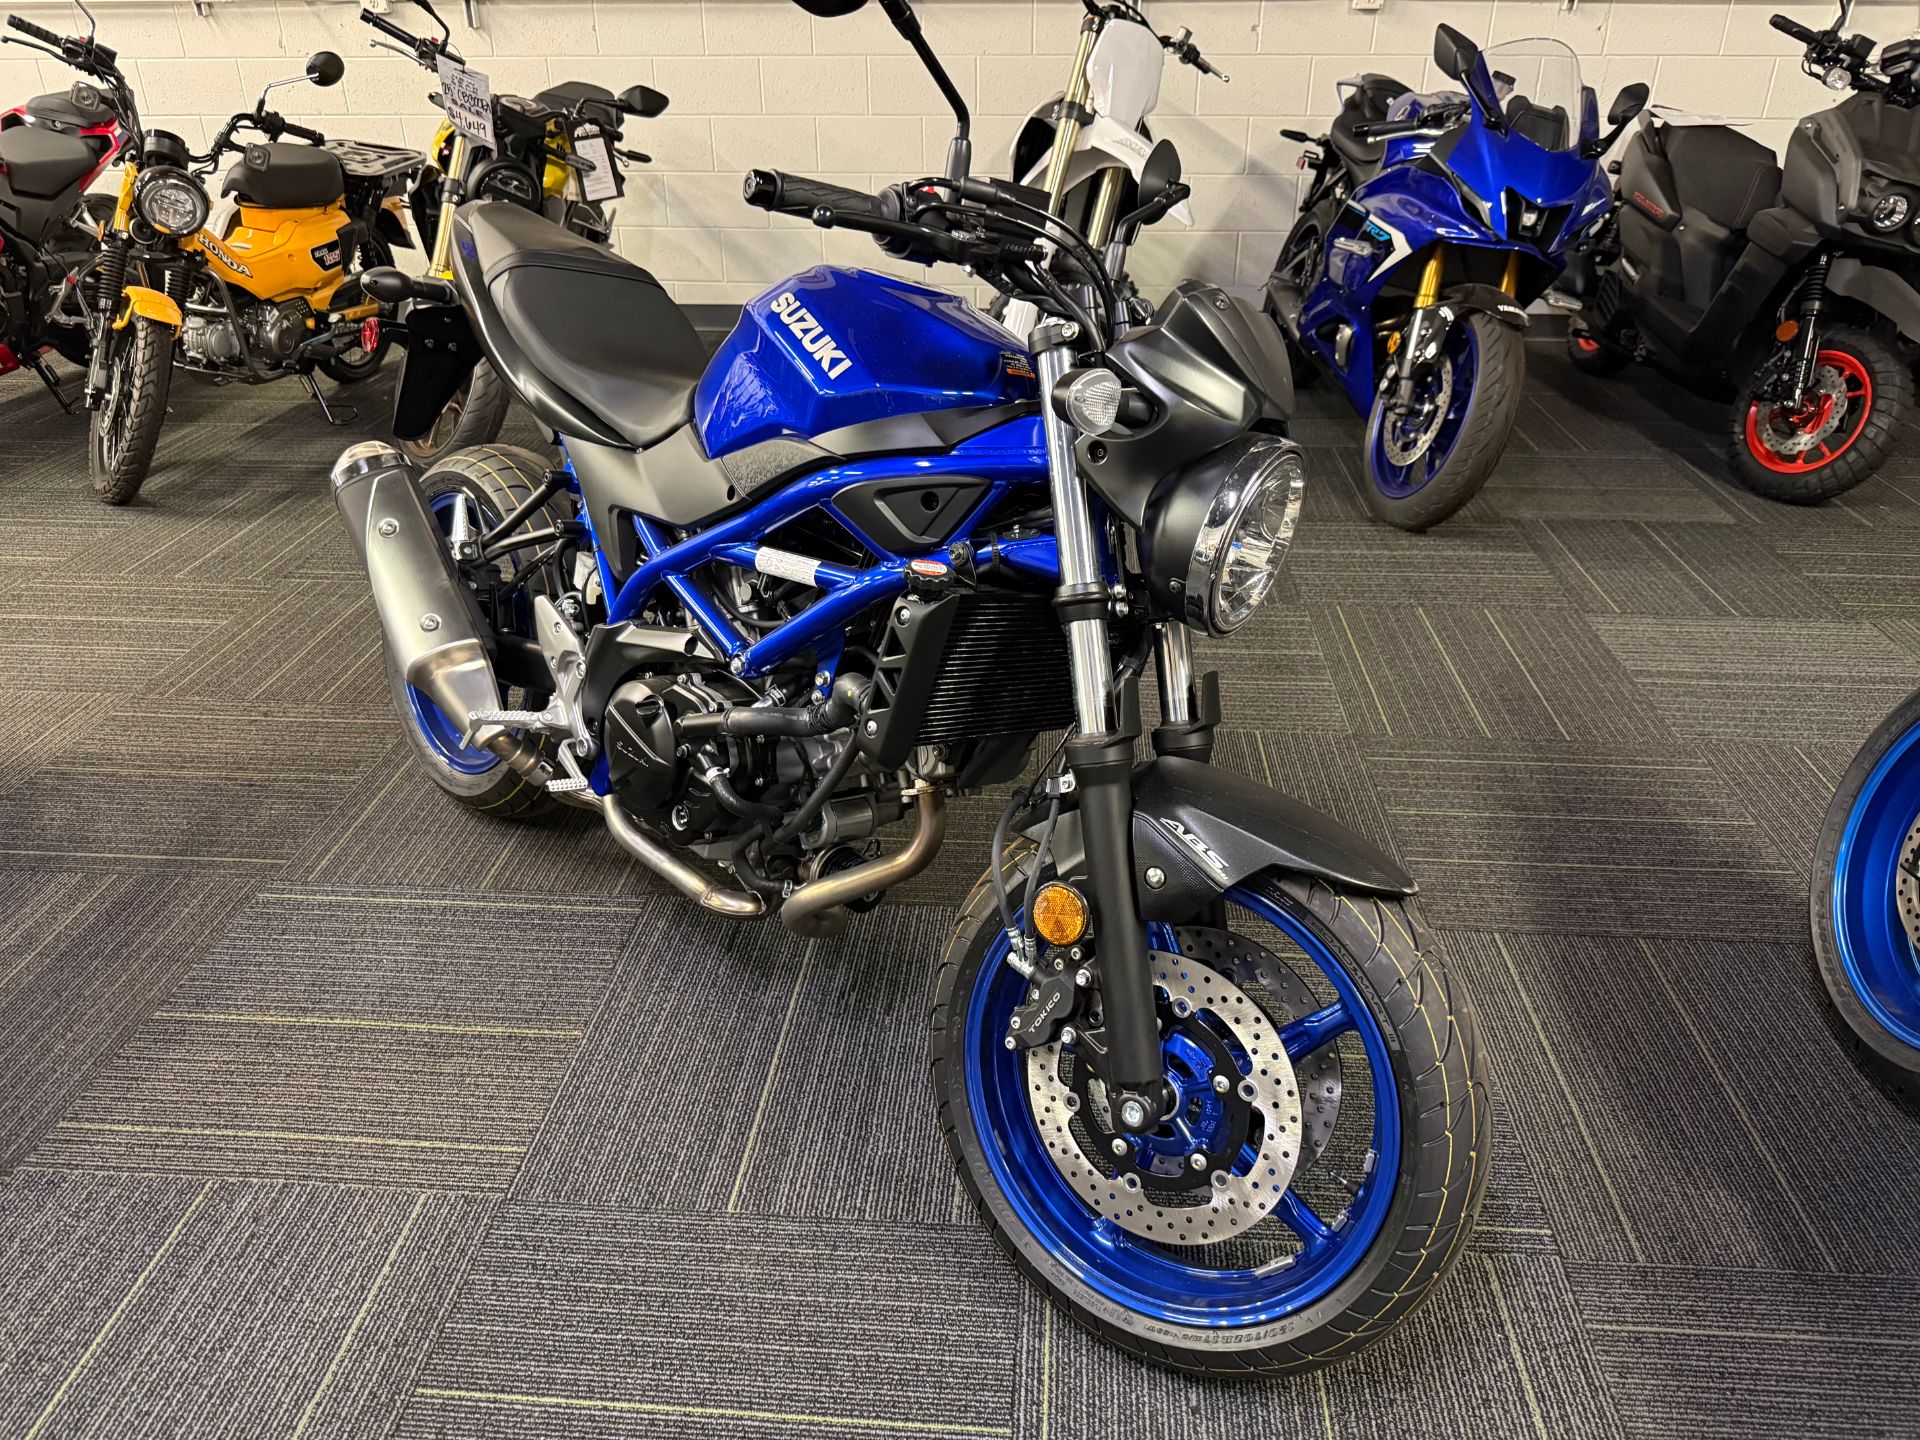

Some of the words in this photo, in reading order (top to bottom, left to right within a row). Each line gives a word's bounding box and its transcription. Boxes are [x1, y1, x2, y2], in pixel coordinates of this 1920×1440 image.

[198, 234, 253, 278] HONDA
[770, 292, 853, 380] SUZUKI
[1159, 817, 1229, 870] ABS
[1028, 992, 1060, 1033] TOKICO
